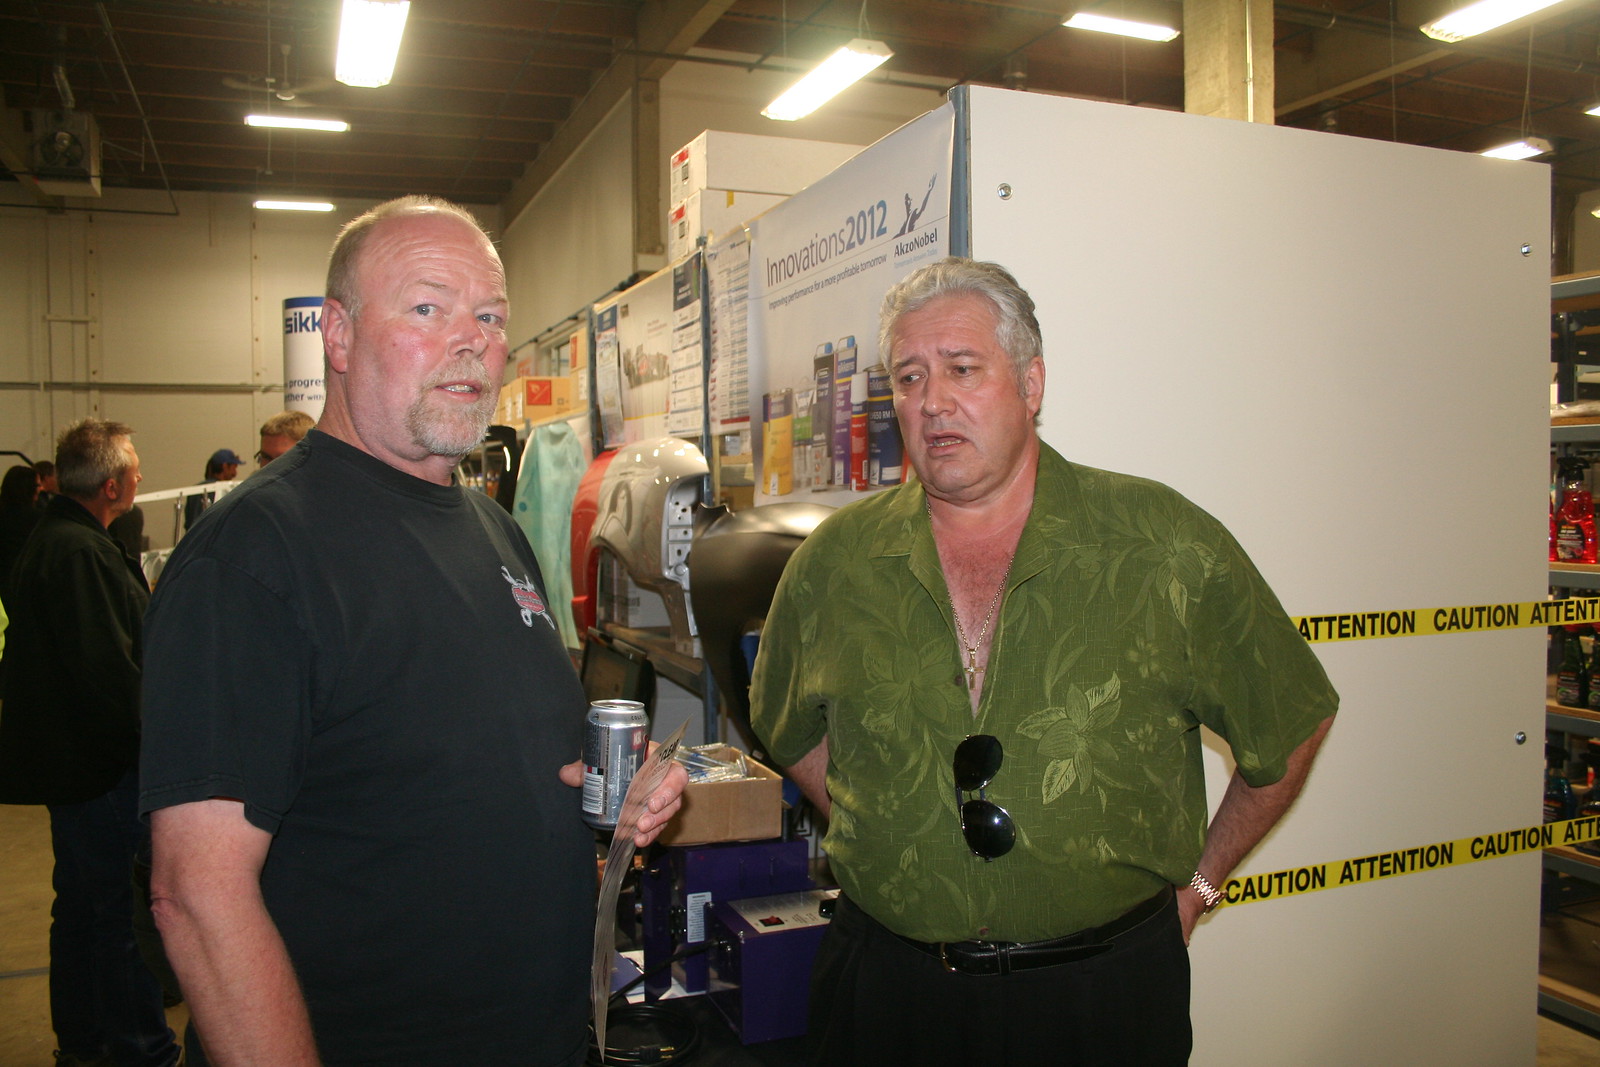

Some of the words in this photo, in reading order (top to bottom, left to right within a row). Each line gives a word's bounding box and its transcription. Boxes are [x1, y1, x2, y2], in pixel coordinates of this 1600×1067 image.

[766, 200, 888, 288] Innovations2012
[894, 227, 938, 258] AkzoNobel
[768, 296, 789, 310] Improving
[788, 284, 814, 303] performance
[824, 275, 837, 287] more
[836, 264, 860, 284] profitable
[860, 254, 887, 273] tomorrow
[1299, 610, 1415, 641] ATTENTION
[1433, 604, 1518, 631] CAUTION
[1225, 865, 1326, 904] CAUTION
[1339, 843, 1453, 884] ATTENTION
[1470, 825, 1553, 860] CAUTION
